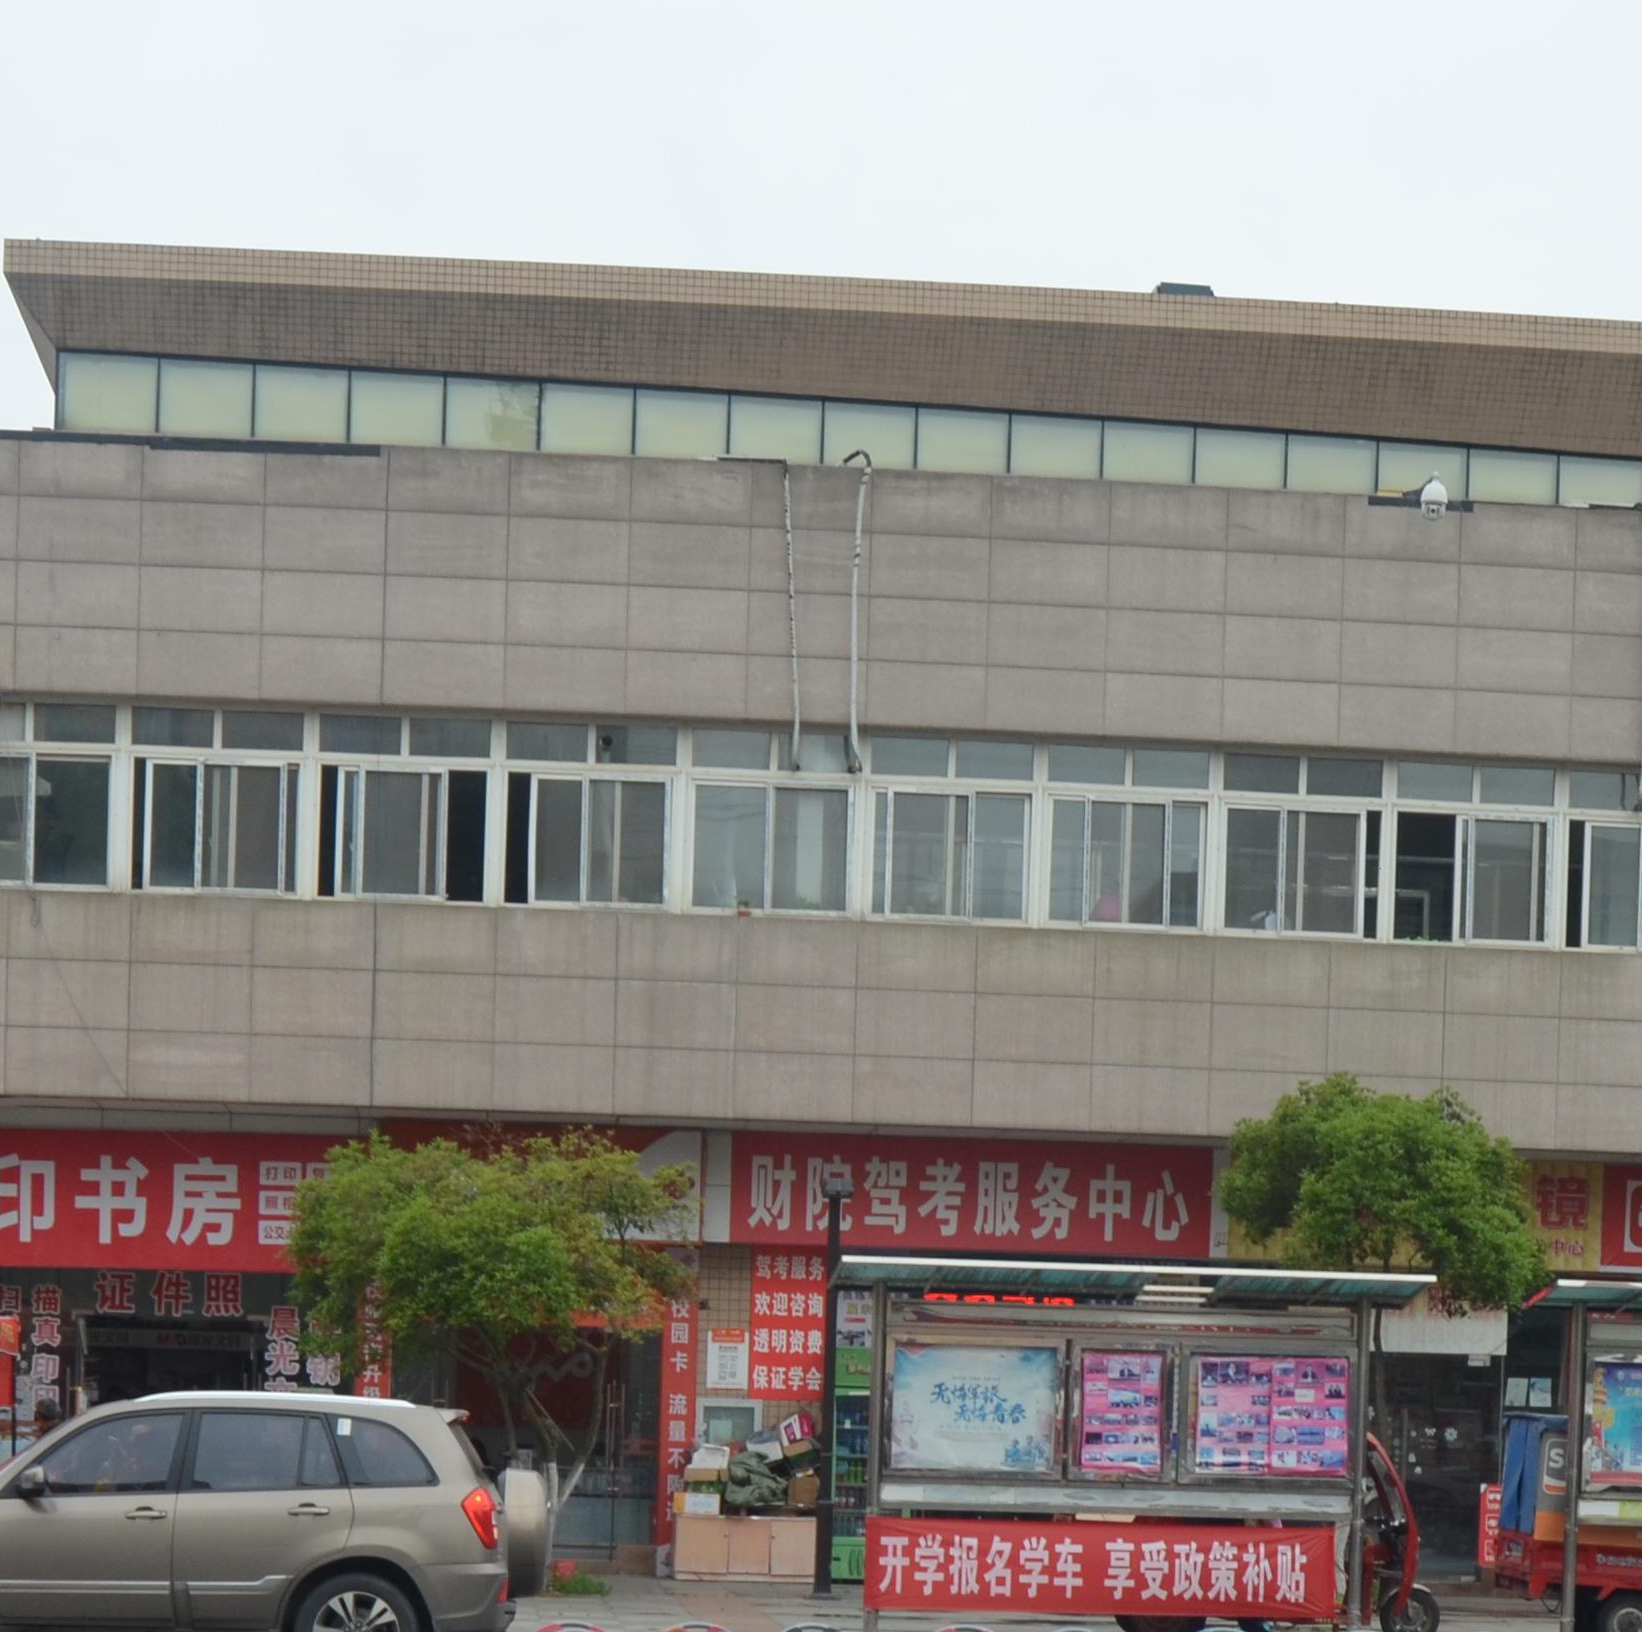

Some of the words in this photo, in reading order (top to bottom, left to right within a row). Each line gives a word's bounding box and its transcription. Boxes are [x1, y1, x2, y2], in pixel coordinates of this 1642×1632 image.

[265, 1167, 297, 1180] 打印
[746, 1153, 1190, 1243] 财院驾考服务中心
[1536, 1174, 1589, 1231] 镜
[755, 1255, 825, 1280] 驾考服务
[95, 1271, 244, 1317] 证件照
[754, 1292, 824, 1318] 欢迎咨询
[670, 1299, 690, 1373] 校园卡
[753, 1329, 823, 1355] 透明资费
[752, 1365, 822, 1391] 保证学会
[877, 1534, 1084, 1599] 开学报名学车
[1104, 1539, 1306, 1603] 享受政策补贴
